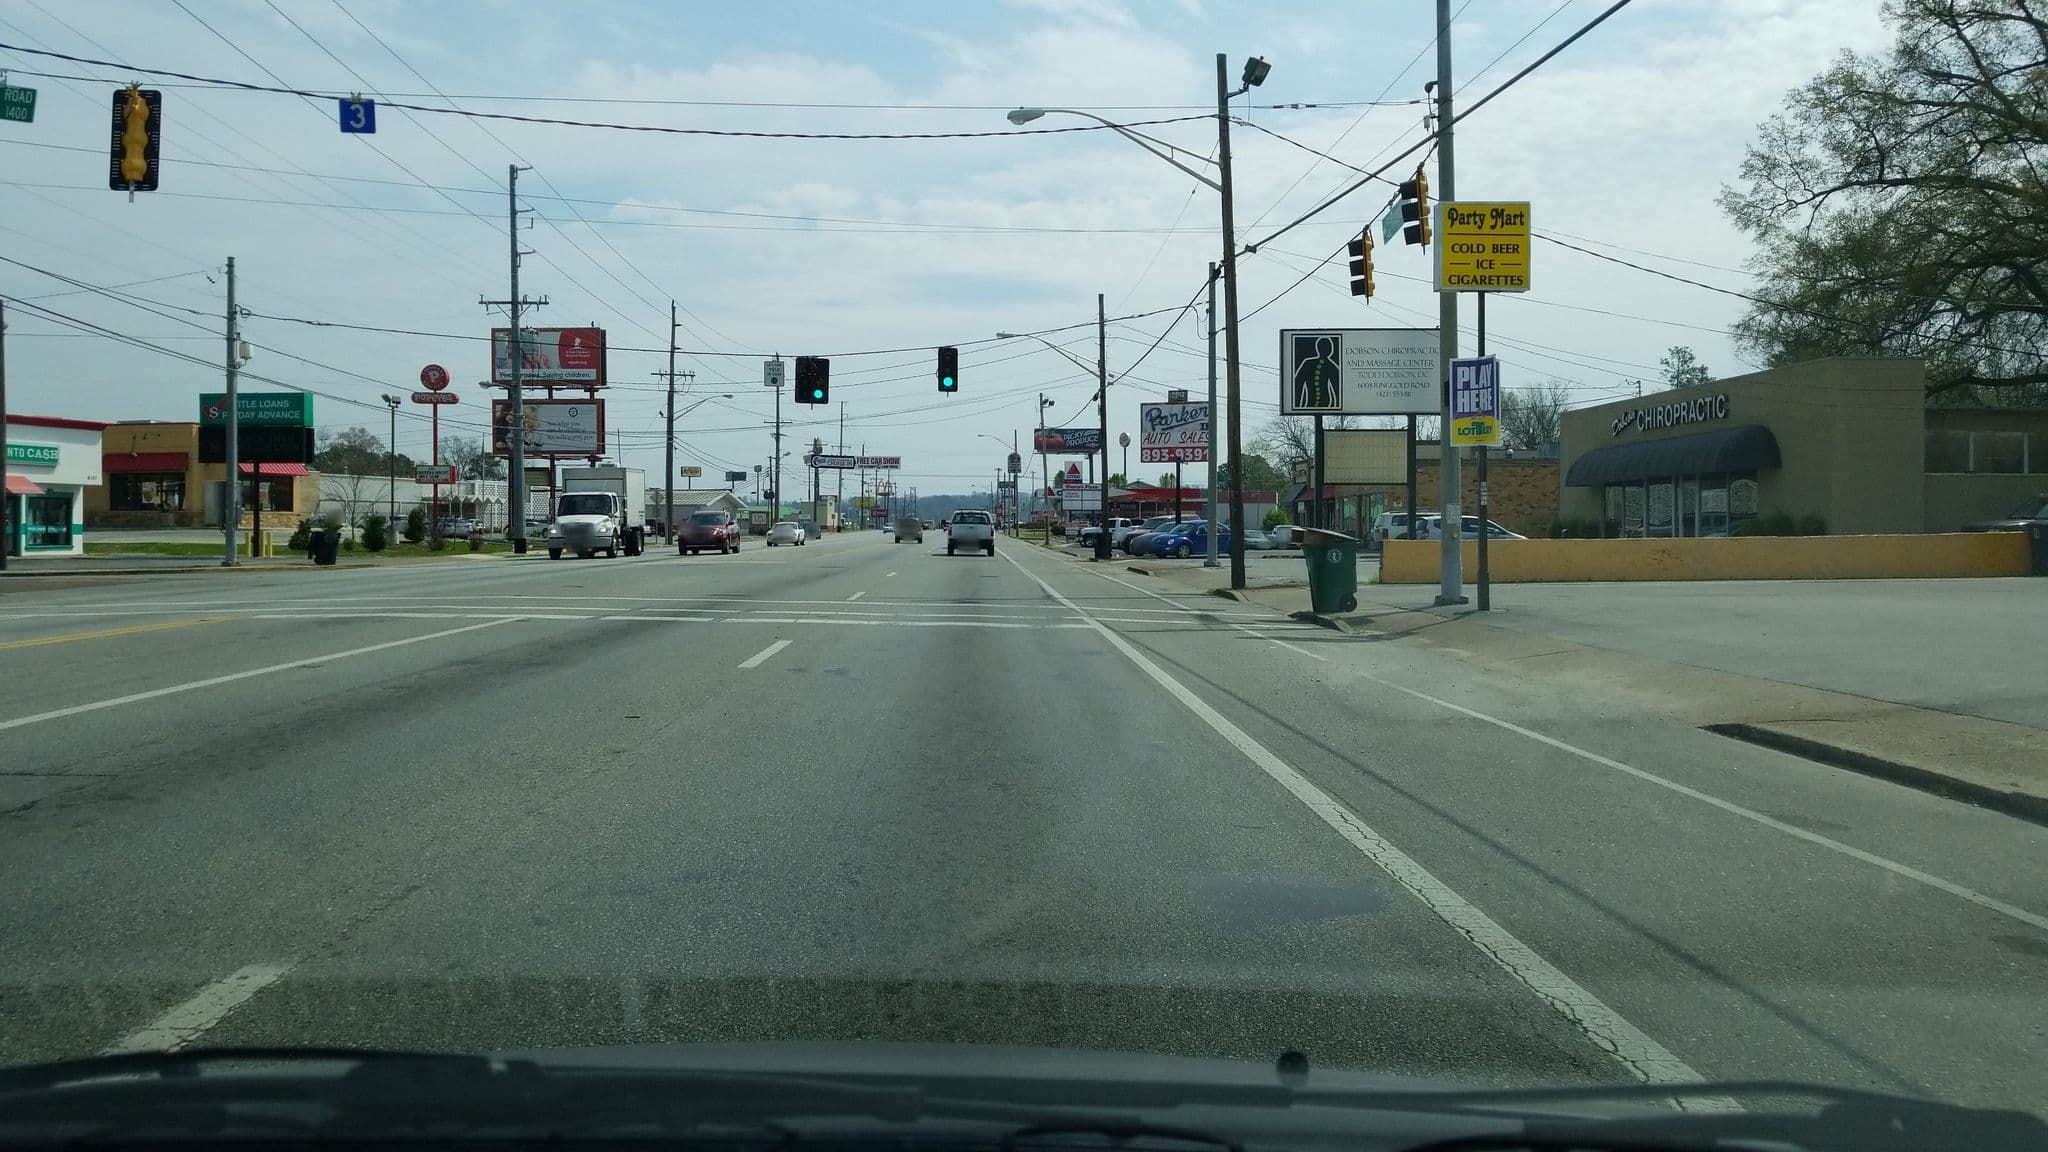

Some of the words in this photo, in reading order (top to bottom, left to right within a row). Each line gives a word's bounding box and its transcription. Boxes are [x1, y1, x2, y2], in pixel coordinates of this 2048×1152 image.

[5, 89, 33, 104] ROAD
[6, 106, 28, 120] 1400
[350, 103, 366, 129] 3
[1448, 207, 1486, 230] Party
[1490, 208, 1525, 230] Mart
[1451, 243, 1486, 254] COLD
[1492, 243, 1521, 254] BEER
[1476, 259, 1495, 270] ICE
[1448, 274, 1524, 286] CIGARETTES
[1345, 347, 1380, 355] DOBSON
[1456, 363, 1493, 390] PLAY
[238, 400, 257, 409] ITLE
[259, 400, 290, 409] LOANS
[1456, 388, 1493, 413] HERE
[257, 411, 301, 420] ADVANCE
[1636, 394, 1726, 432] CHIROPRACTIC
[1142, 432, 1171, 445] AUTO
[7, 447, 25, 458] NTO
[856, 457, 870, 465] FREE
[871, 457, 883, 465] CAR
[883, 457, 900, 465] SHOW
